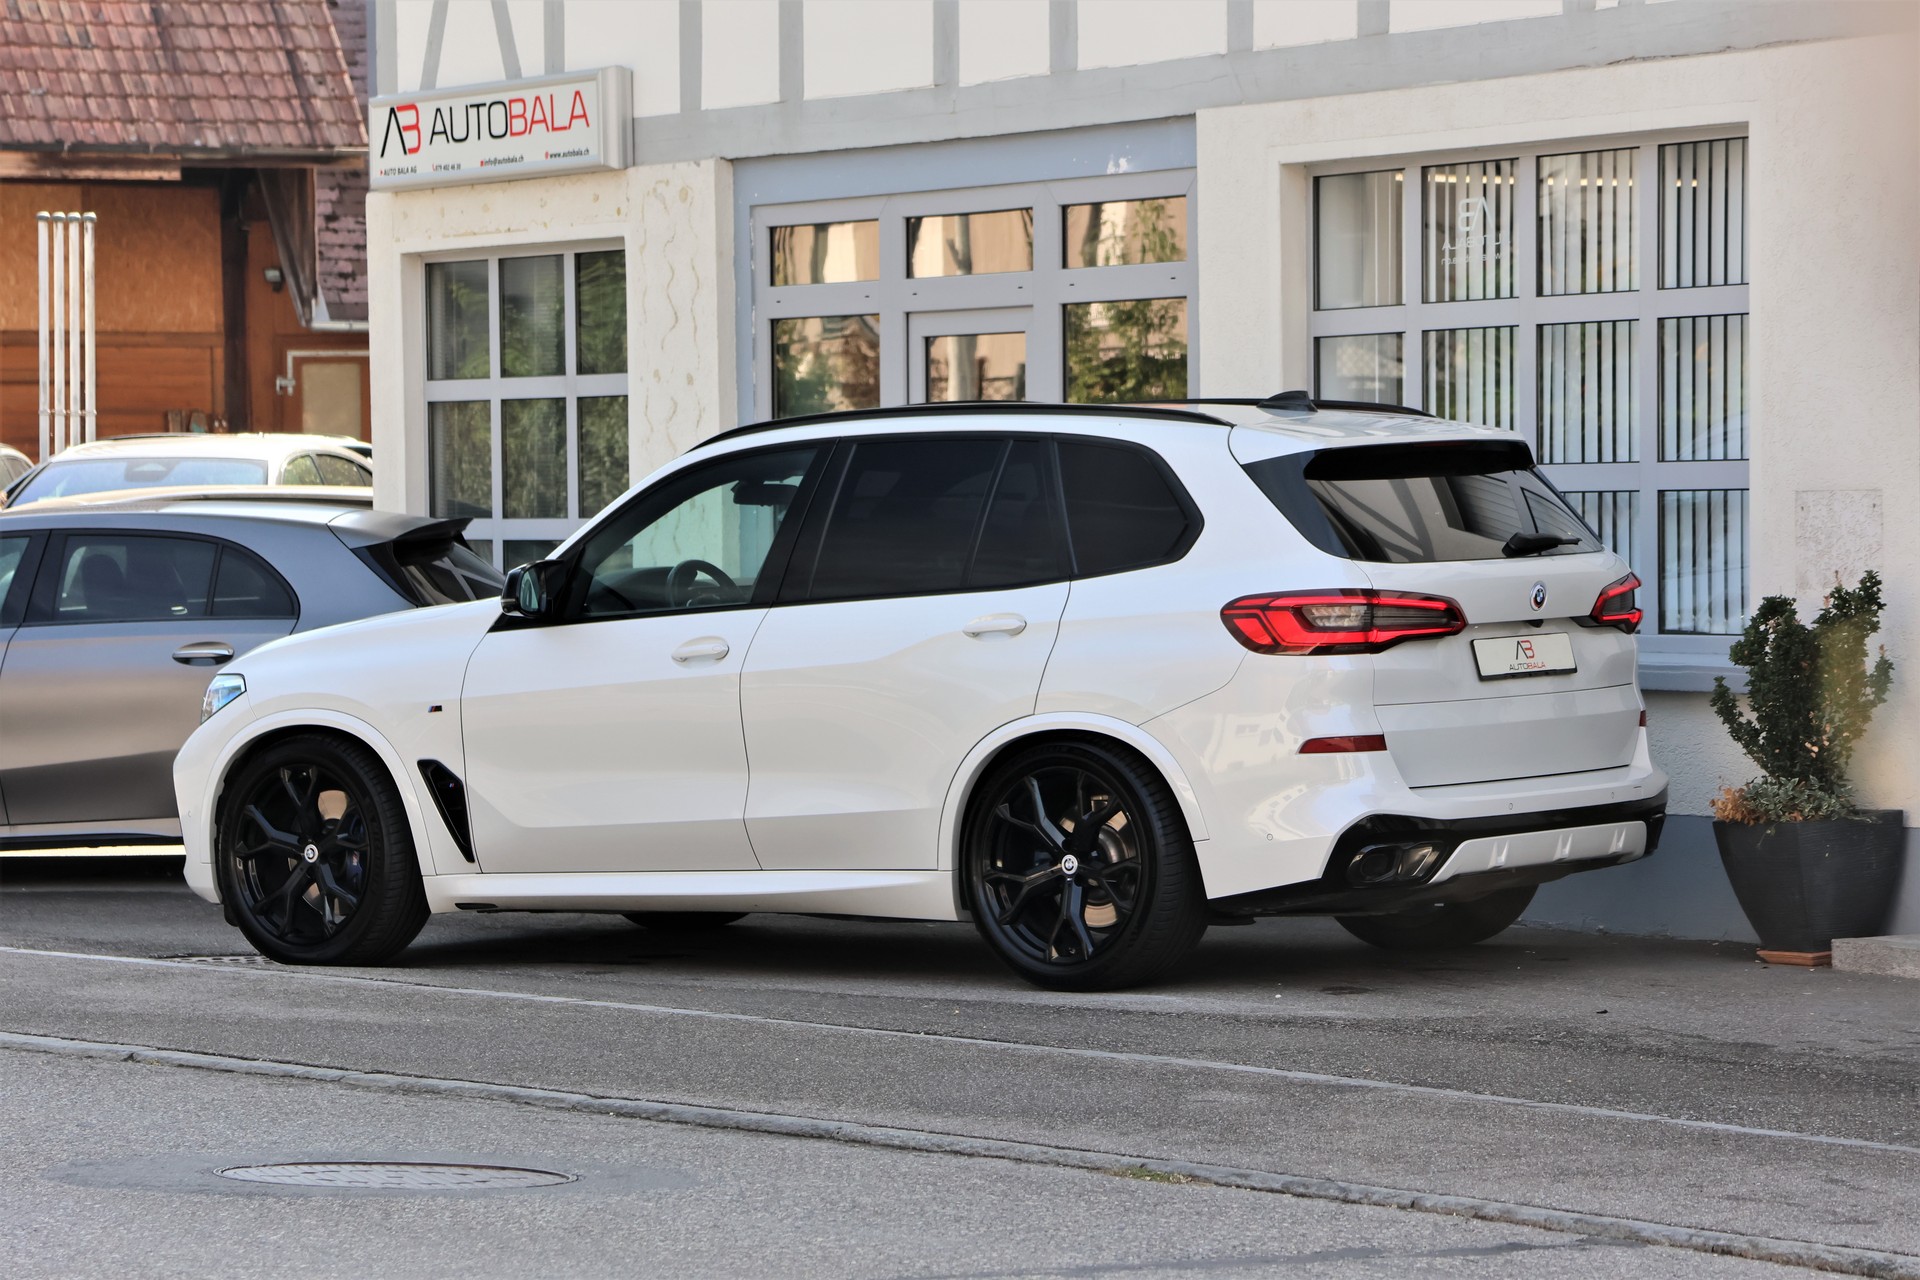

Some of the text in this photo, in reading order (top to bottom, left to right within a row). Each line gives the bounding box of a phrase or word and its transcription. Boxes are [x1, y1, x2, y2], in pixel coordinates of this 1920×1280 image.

[429, 90, 590, 145] AUTOBALA
[549, 147, 590, 159] www.autobala.ch
[484, 154, 524, 167] info@autobala.ch
[384, 165, 417, 176] AUTO BALA AG
[1509, 661, 1546, 671] AUTOBALA
